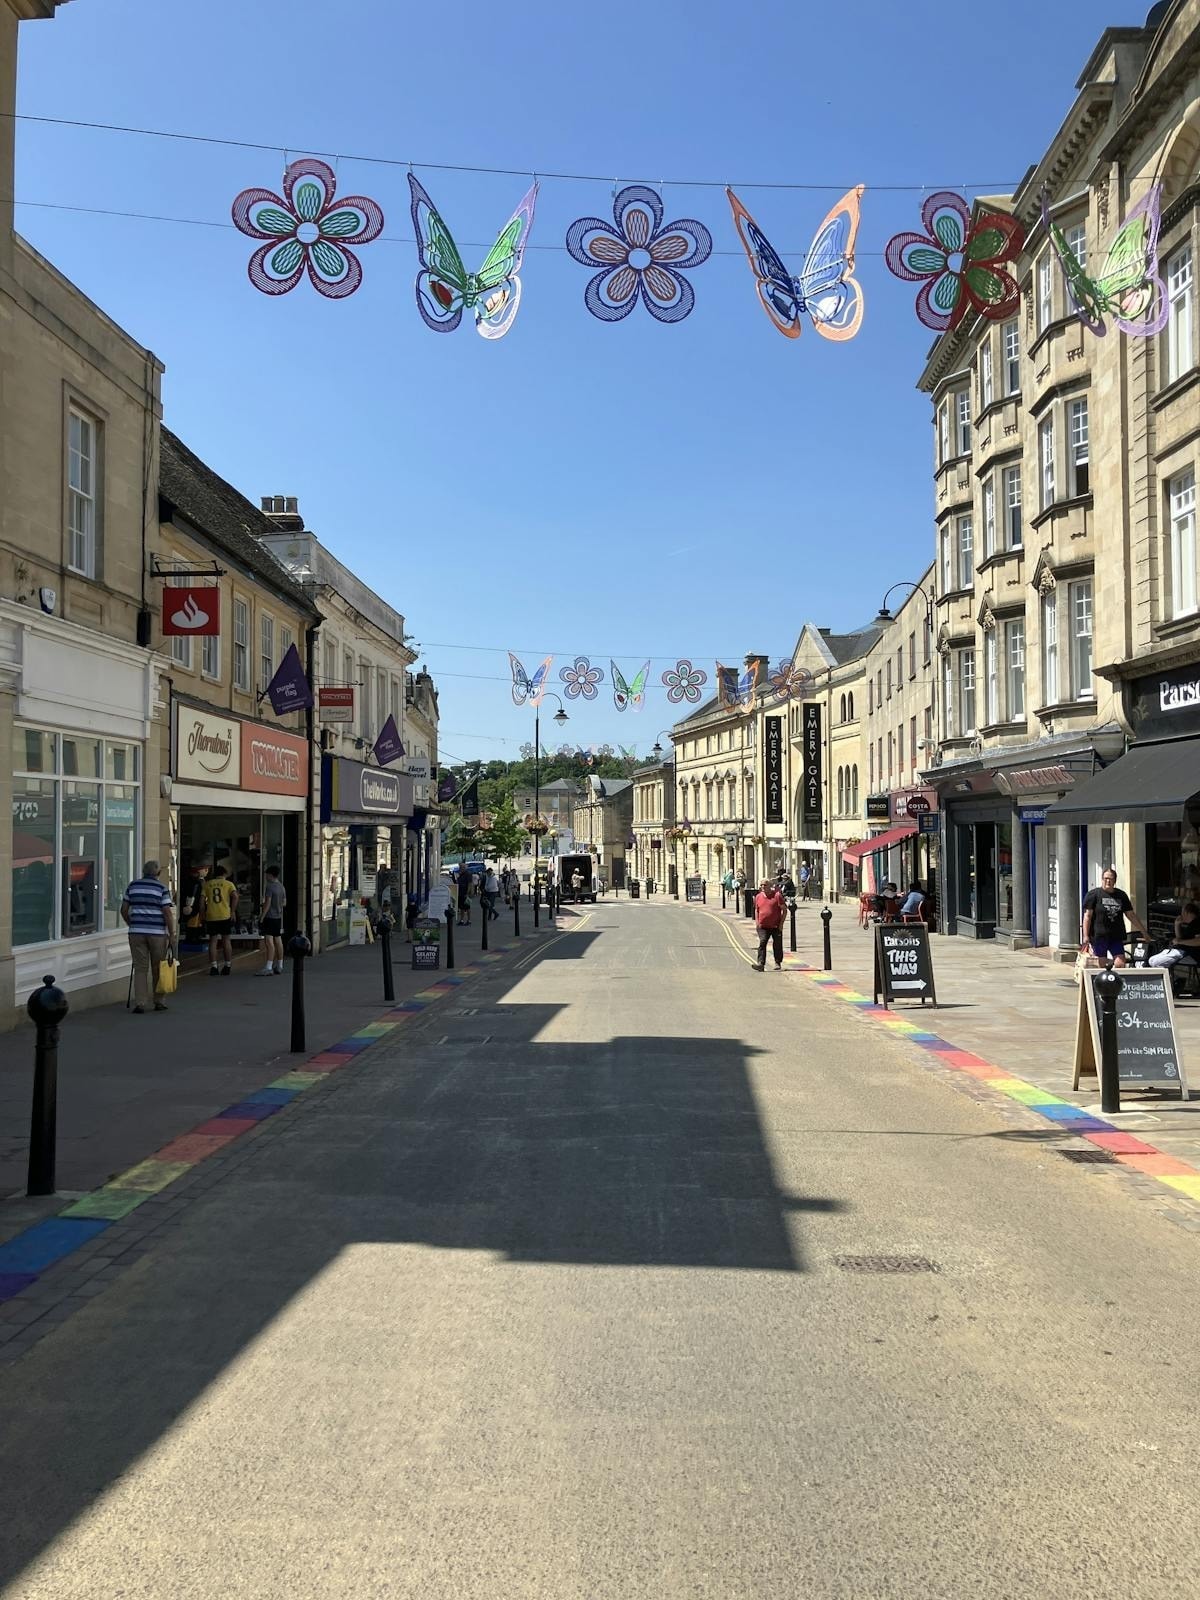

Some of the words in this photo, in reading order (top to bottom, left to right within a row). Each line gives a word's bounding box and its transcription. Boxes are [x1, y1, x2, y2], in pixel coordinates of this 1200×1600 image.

[277, 683, 295, 693] purple
[188, 721, 232, 757] Thorntons
[807, 708, 817, 761] EMERY
[769, 721, 778, 768] EMERY
[769, 772, 778, 810] GATE
[808, 765, 817, 808] GATE
[213, 888, 221, 904] 8
[884, 936, 920, 947] Parsons
[887, 949, 917, 963] THIS
[890, 963, 917, 975] WAY
[1157, 1047, 1173, 1055] Plan
